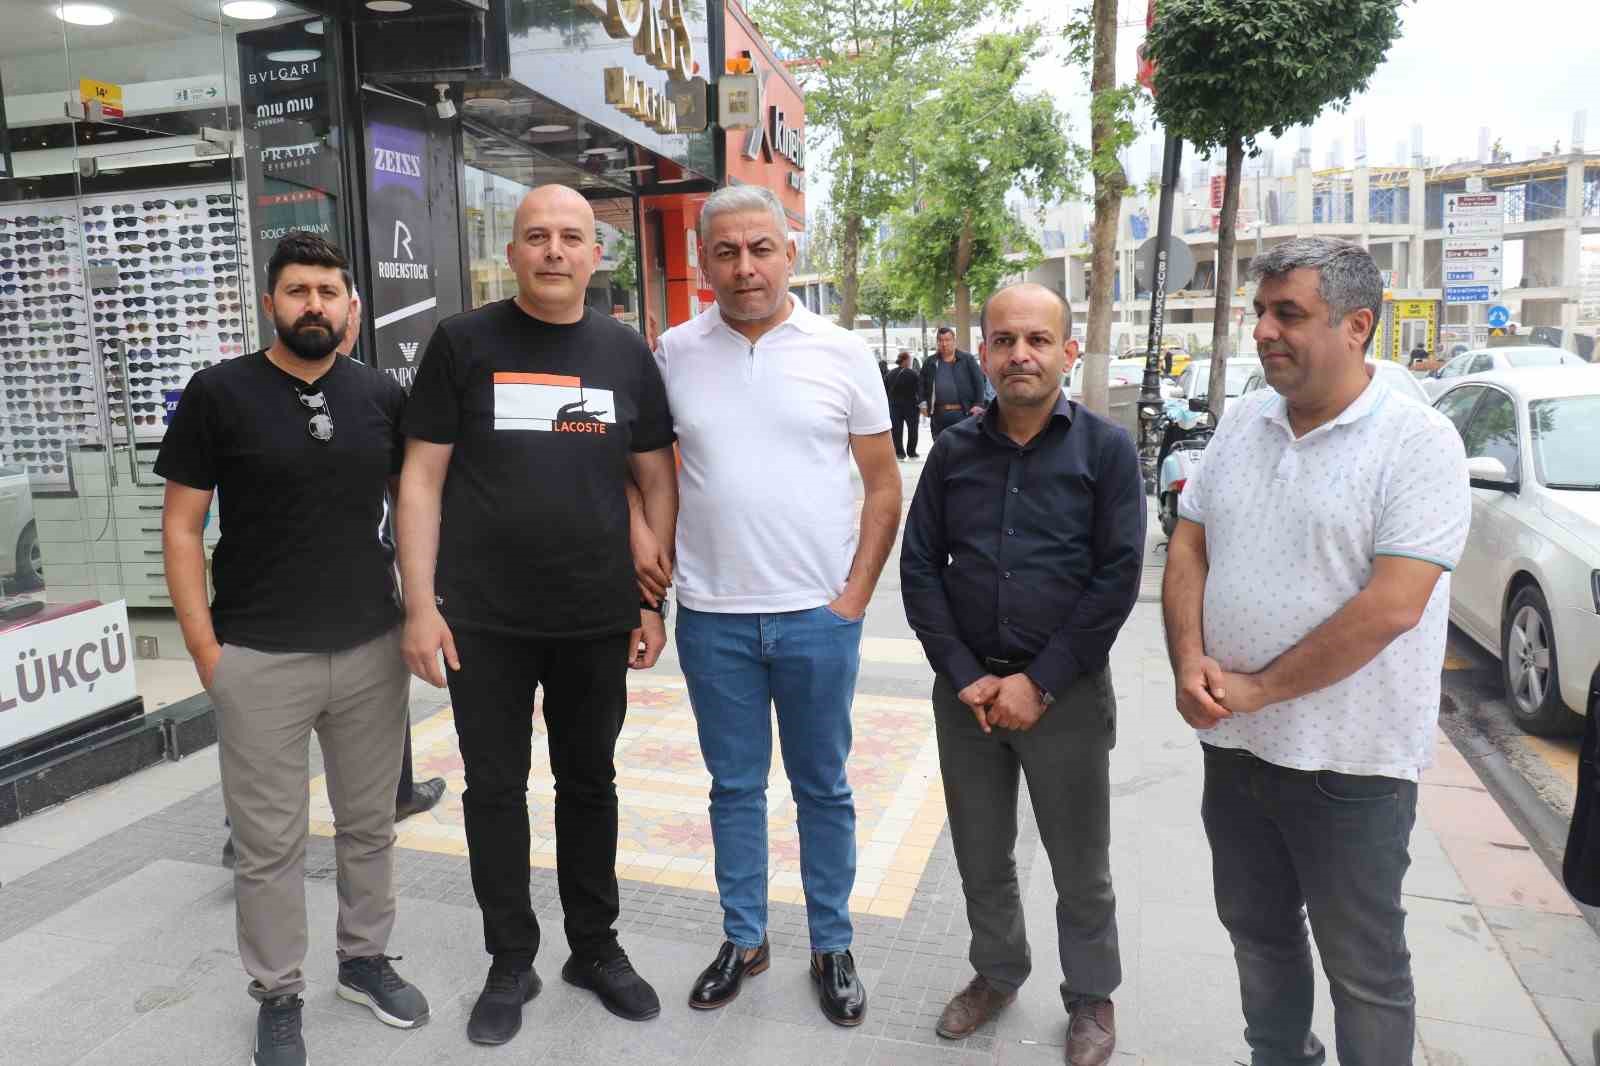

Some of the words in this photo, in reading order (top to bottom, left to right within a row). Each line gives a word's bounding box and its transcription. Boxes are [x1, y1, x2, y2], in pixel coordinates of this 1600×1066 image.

[249, 62, 317, 85] BVLGARI
[257, 102, 284, 119] MIU
[286, 96, 314, 114] MIU
[260, 145, 317, 162] PRADA
[374, 147, 421, 177] ZEISS
[378, 261, 429, 280] RODENSTOCK
[554, 422, 607, 434] LACOSTE
